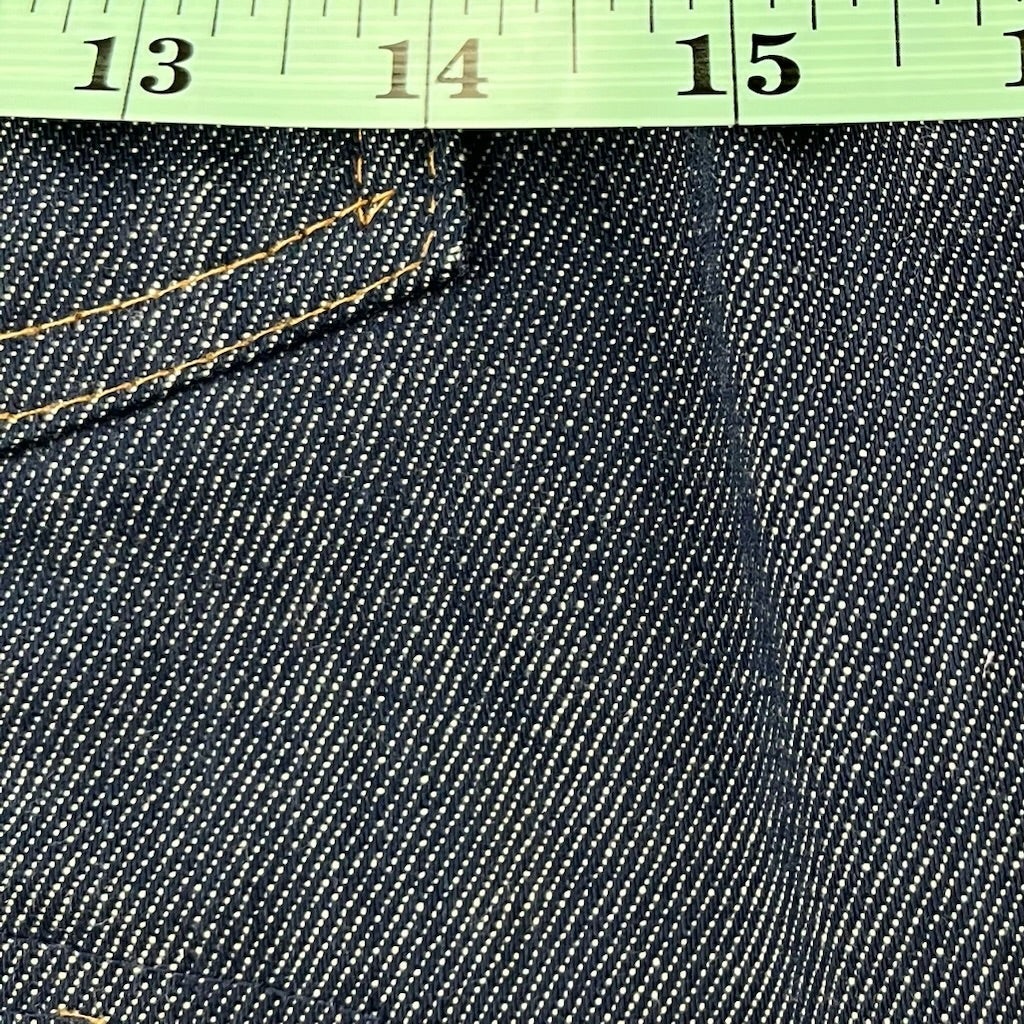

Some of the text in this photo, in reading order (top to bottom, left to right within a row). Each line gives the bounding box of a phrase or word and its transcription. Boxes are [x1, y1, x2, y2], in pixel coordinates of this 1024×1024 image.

[74, 36, 194, 94] 13
[375, 38, 488, 100] 14
[676, 32, 801, 96] 15
